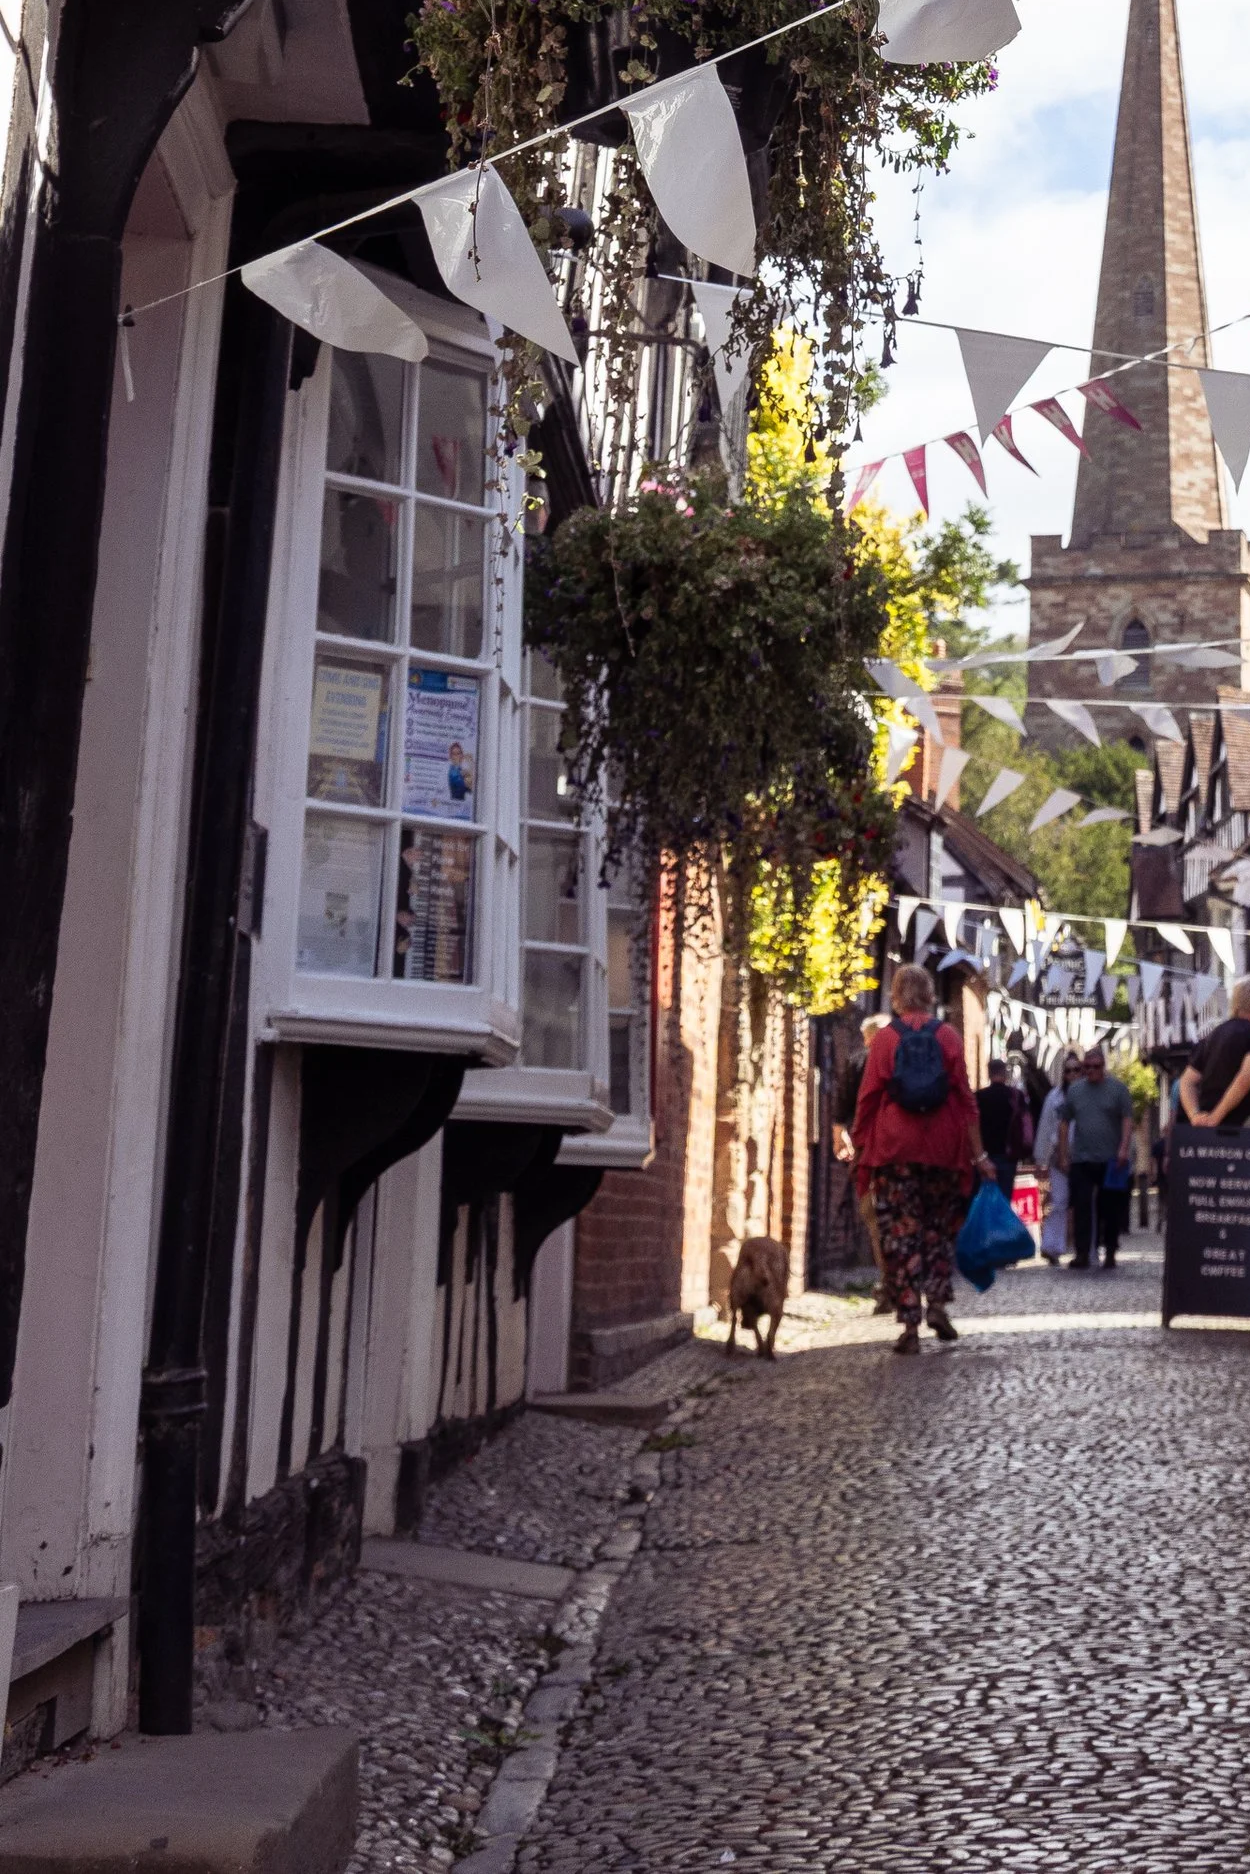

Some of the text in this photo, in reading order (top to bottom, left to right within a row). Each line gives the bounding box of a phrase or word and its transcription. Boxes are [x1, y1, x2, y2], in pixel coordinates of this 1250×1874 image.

[1179, 1146, 1195, 1159] LA
[1196, 1146, 1244, 1160] MAISON
[1188, 1176, 1217, 1189] NOW
[1188, 1194, 1216, 1208] FULL
[1203, 1247, 1245, 1262] GREAT
[1200, 1265, 1246, 1278] COFFEE
